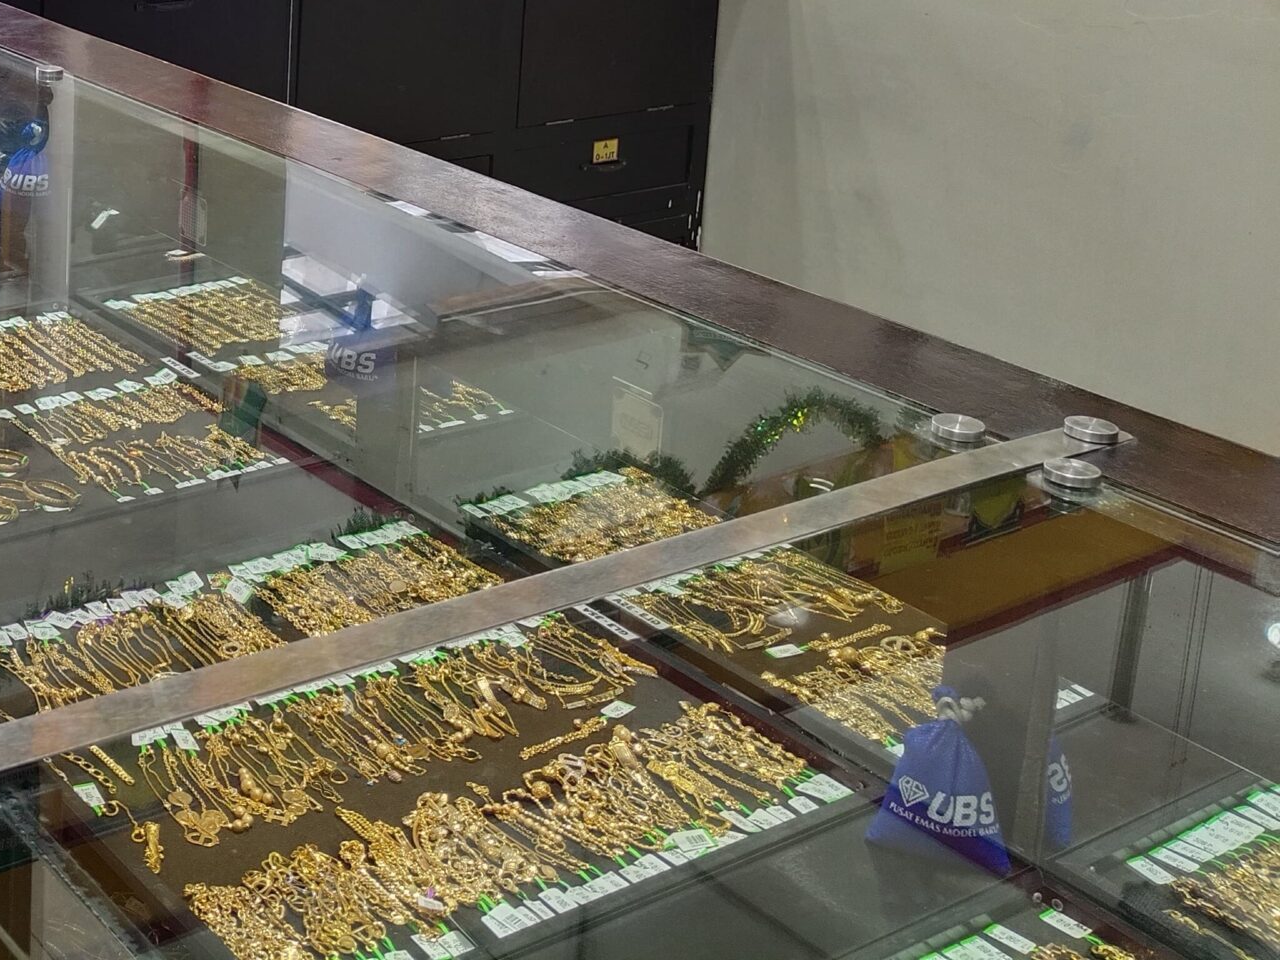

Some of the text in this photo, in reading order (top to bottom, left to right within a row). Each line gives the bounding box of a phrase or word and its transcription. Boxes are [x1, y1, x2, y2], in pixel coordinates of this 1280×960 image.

[602, 141, 609, 150] A
[10, 173, 50, 192] UBS
[888, 801, 915, 822] PUSAT
[914, 815, 941, 834] EMAS
[942, 827, 978, 838] MODEL
[926, 791, 996, 827] UBS
